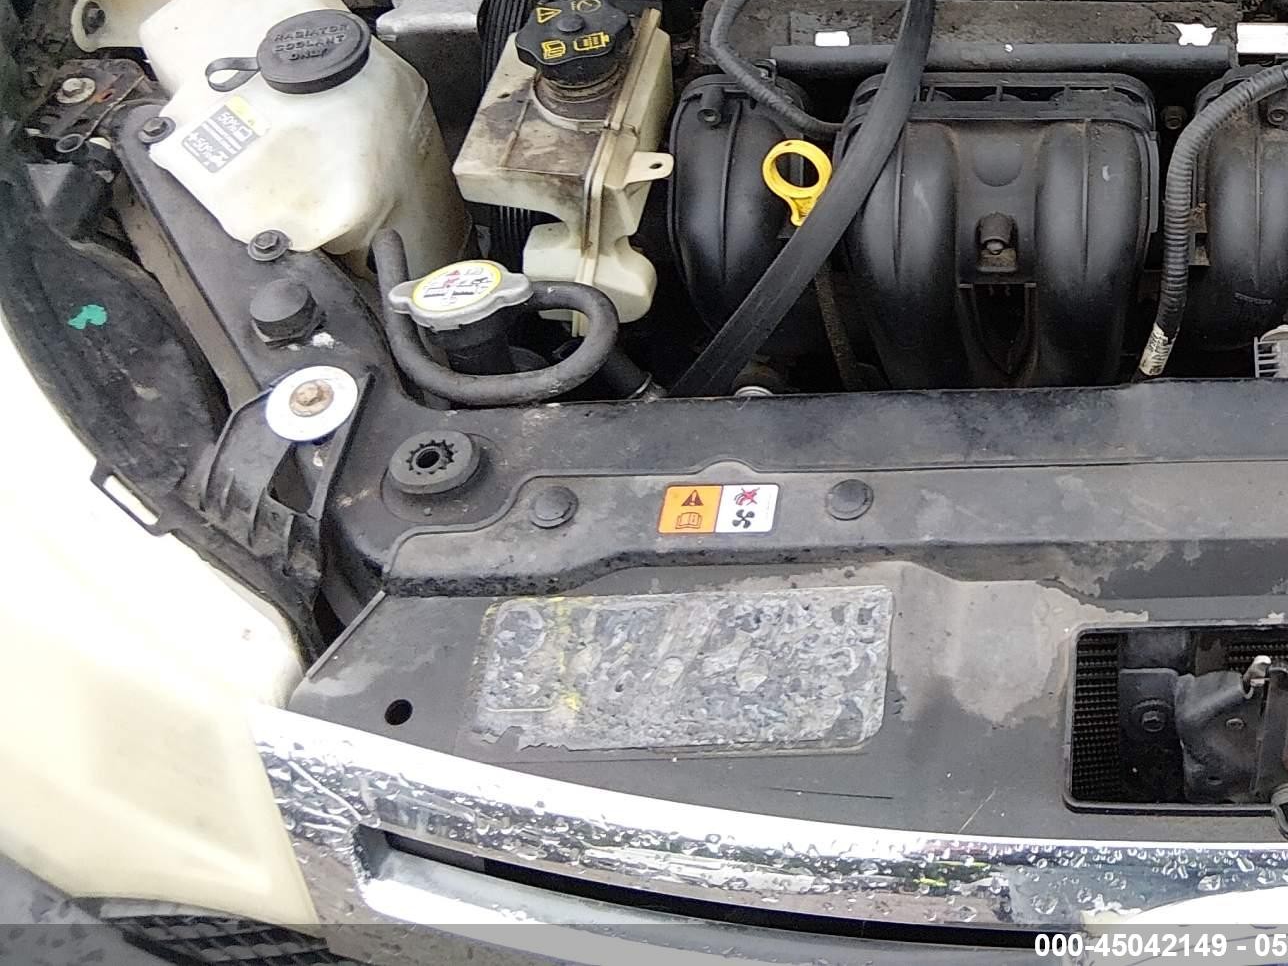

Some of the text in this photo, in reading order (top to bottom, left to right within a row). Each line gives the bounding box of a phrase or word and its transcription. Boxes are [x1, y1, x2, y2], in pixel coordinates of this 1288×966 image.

[274, 25, 348, 42] RADIATOR
[275, 35, 345, 52] COOLANT
[288, 48, 329, 61] ONLY
